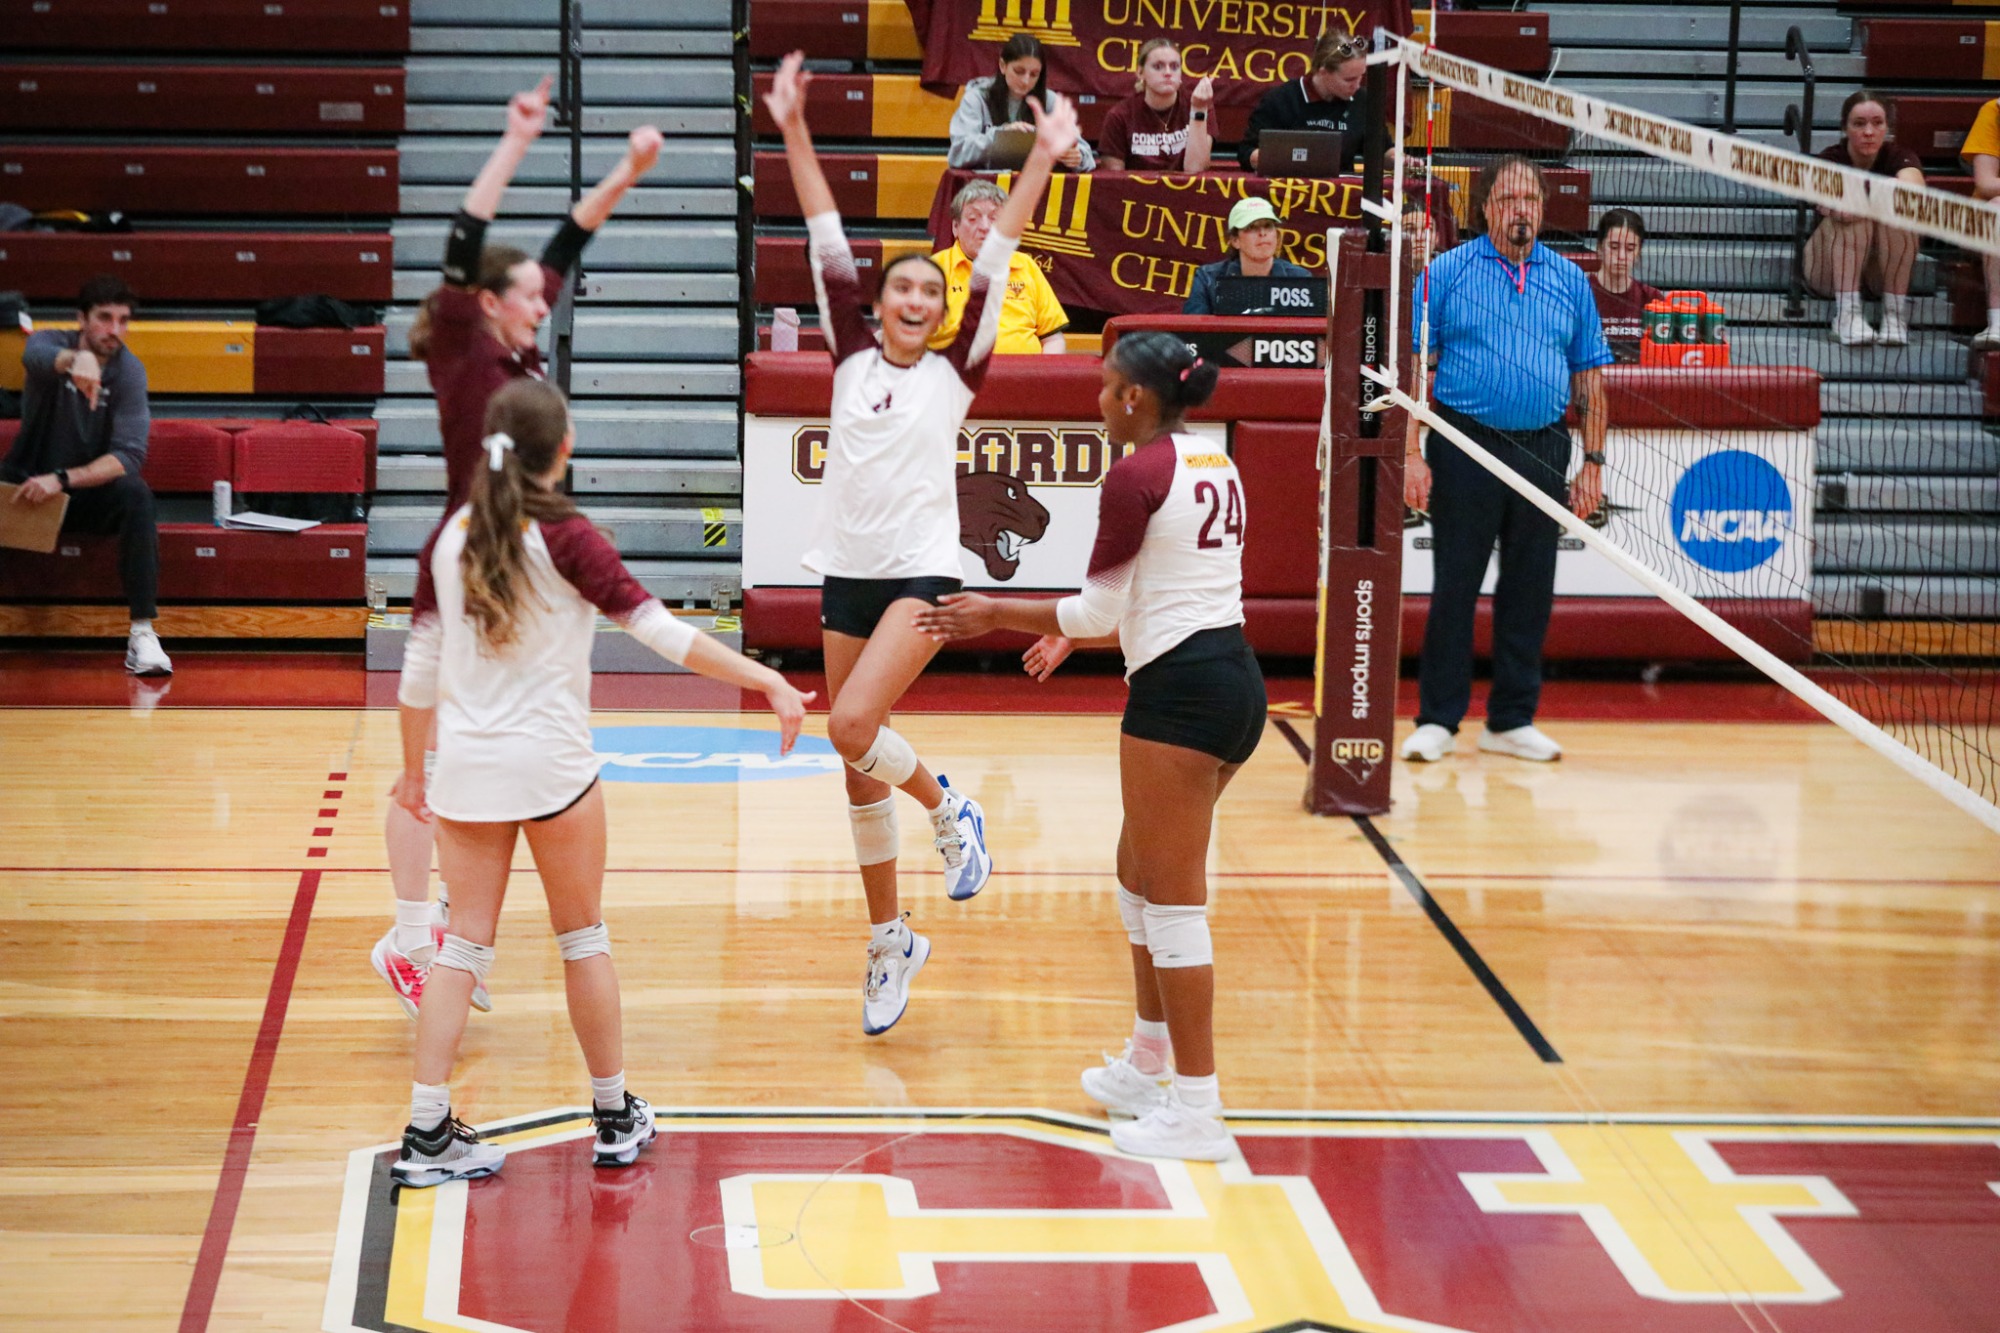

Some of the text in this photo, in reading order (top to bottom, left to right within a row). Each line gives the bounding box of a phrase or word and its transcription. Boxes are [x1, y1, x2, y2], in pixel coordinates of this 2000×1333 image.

[1103, 0, 1366, 39] UNIVERSITY
[1097, 37, 1312, 83] CCAGO
[1270, 287, 1314, 307] POSS.
[1363, 316, 1377, 362] sports
[1655, 323, 1671, 338] G
[1254, 339, 1316, 363] POSS
[1194, 479, 1243, 550] 24
[1681, 509, 1791, 542] NCAA
[1350, 579, 1374, 719] sports imports
[1332, 738, 1385, 765] CUC
